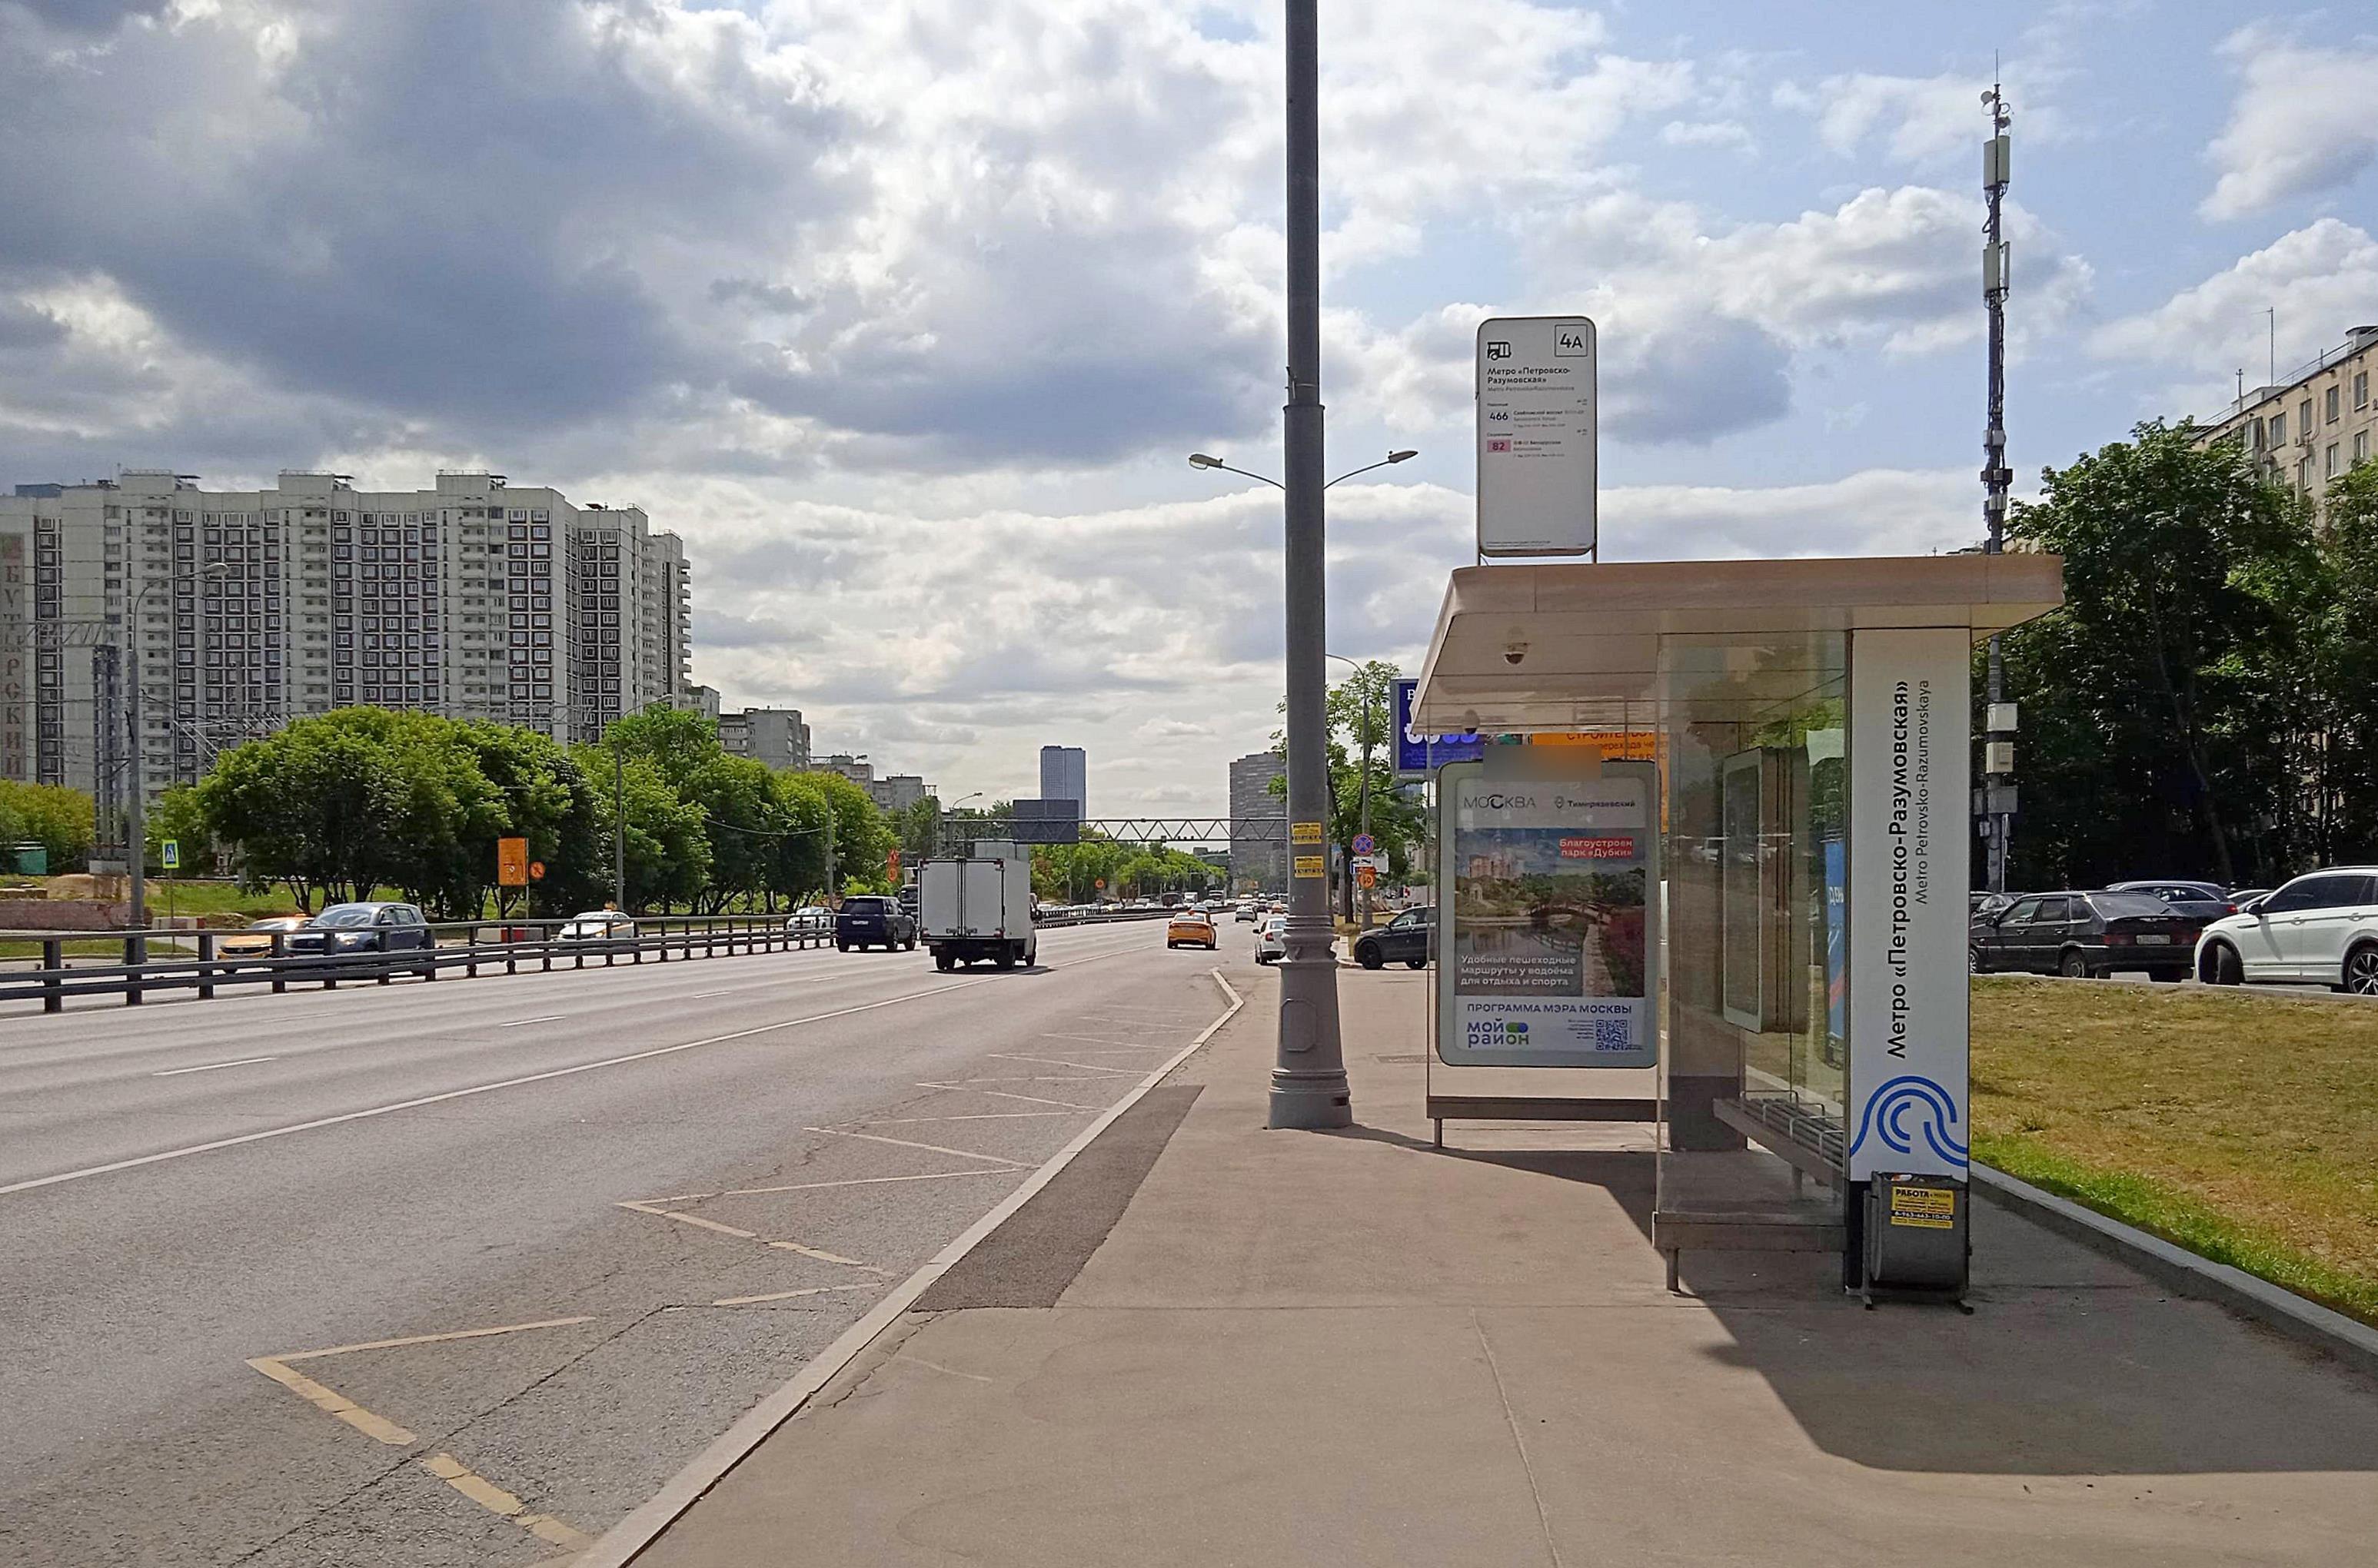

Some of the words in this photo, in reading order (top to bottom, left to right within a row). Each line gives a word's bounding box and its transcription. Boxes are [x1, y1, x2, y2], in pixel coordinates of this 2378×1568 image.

[1487, 377, 1547, 385] Разумовская»
[1489, 412, 1508, 421] 466
[1915, 680, 1931, 856] Petrovsko-Razumovskaya
[1463, 794, 1536, 809] МОСКВА
[1887, 681, 1912, 978] «Петровско-Разумовская»
[1561, 849, 1585, 858] парк
[1915, 862, 1928, 905] Metro
[1462, 955, 1506, 965] Удобные
[1509, 956, 1576, 965] пешеходные
[1462, 967, 1517, 977] маршруты
[1519, 968, 1525, 976] у
[1482, 978, 1520, 986] отдыха
[1532, 978, 1568, 987] спорта
[1467, 1004, 1541, 1013] ПРОГРАММА
[1543, 1005, 1577, 1014] МЭРА
[1580, 1005, 1631, 1015] МОСКВЫ
[1467, 1018, 1505, 1033] мой
[1887, 984, 1911, 1059] Метро
[1468, 1034, 1529, 1048] район
[1895, 1189, 1929, 1198] РАБОТА
